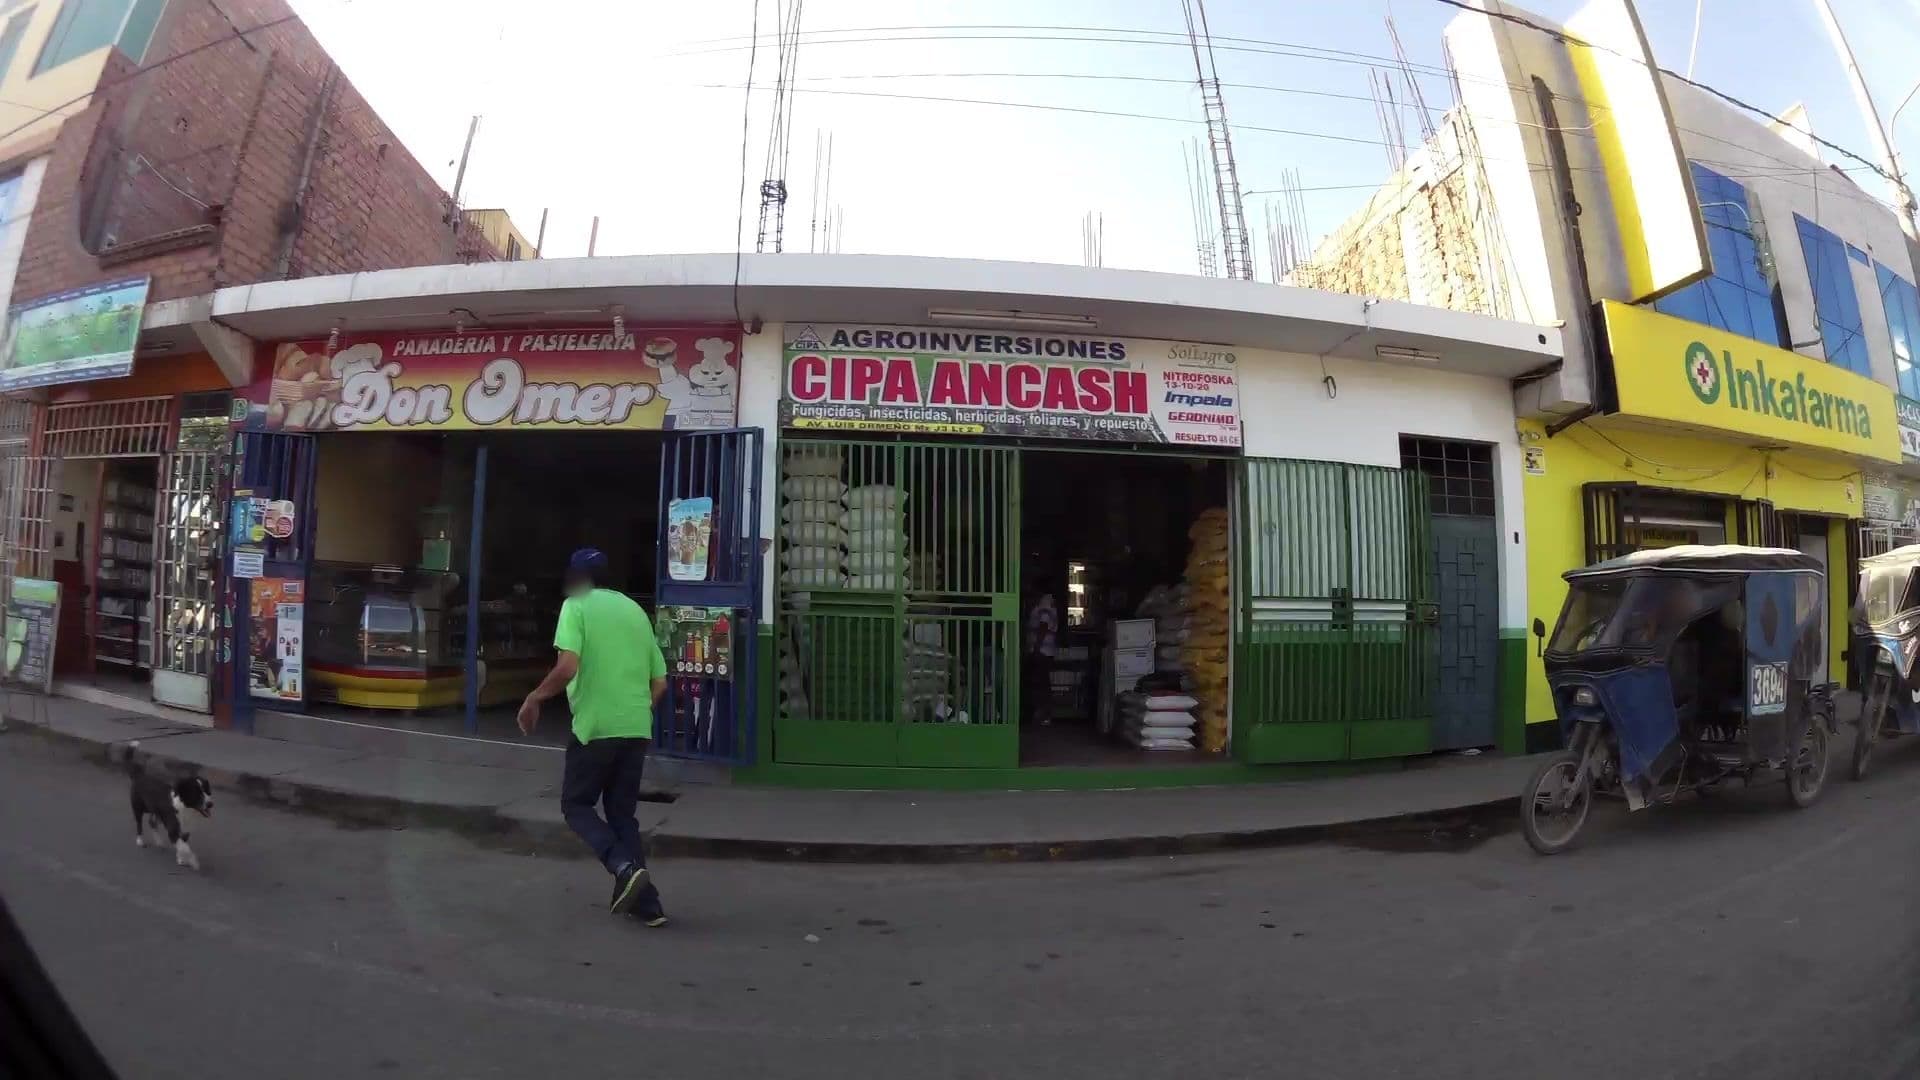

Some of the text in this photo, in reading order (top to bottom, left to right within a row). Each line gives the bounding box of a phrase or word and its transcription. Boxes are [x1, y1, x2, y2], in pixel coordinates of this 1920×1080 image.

[393, 333, 636, 356] PANADERIA Y PASTELERIA
[830, 328, 1126, 360] AGROINVERSIONES
[790, 355, 1149, 415] CIPA ANCASH
[1163, 371, 1234, 386] NITROFOSKA
[1165, 381, 1209, 391] 13-10-20
[330, 358, 656, 427] Don Omer
[1164, 391, 1233, 408] Impala
[1723, 350, 1873, 439] Inkafarma
[792, 404, 1154, 432] Fungicidas, insecticidas, herbicidas, foliares, y repuestos
[828, 421, 854, 429] LUIS
[1168, 411, 1234, 424] GERONIMO
[1175, 432, 1218, 443] RESUELTO
[1753, 666, 1784, 705] 3694
